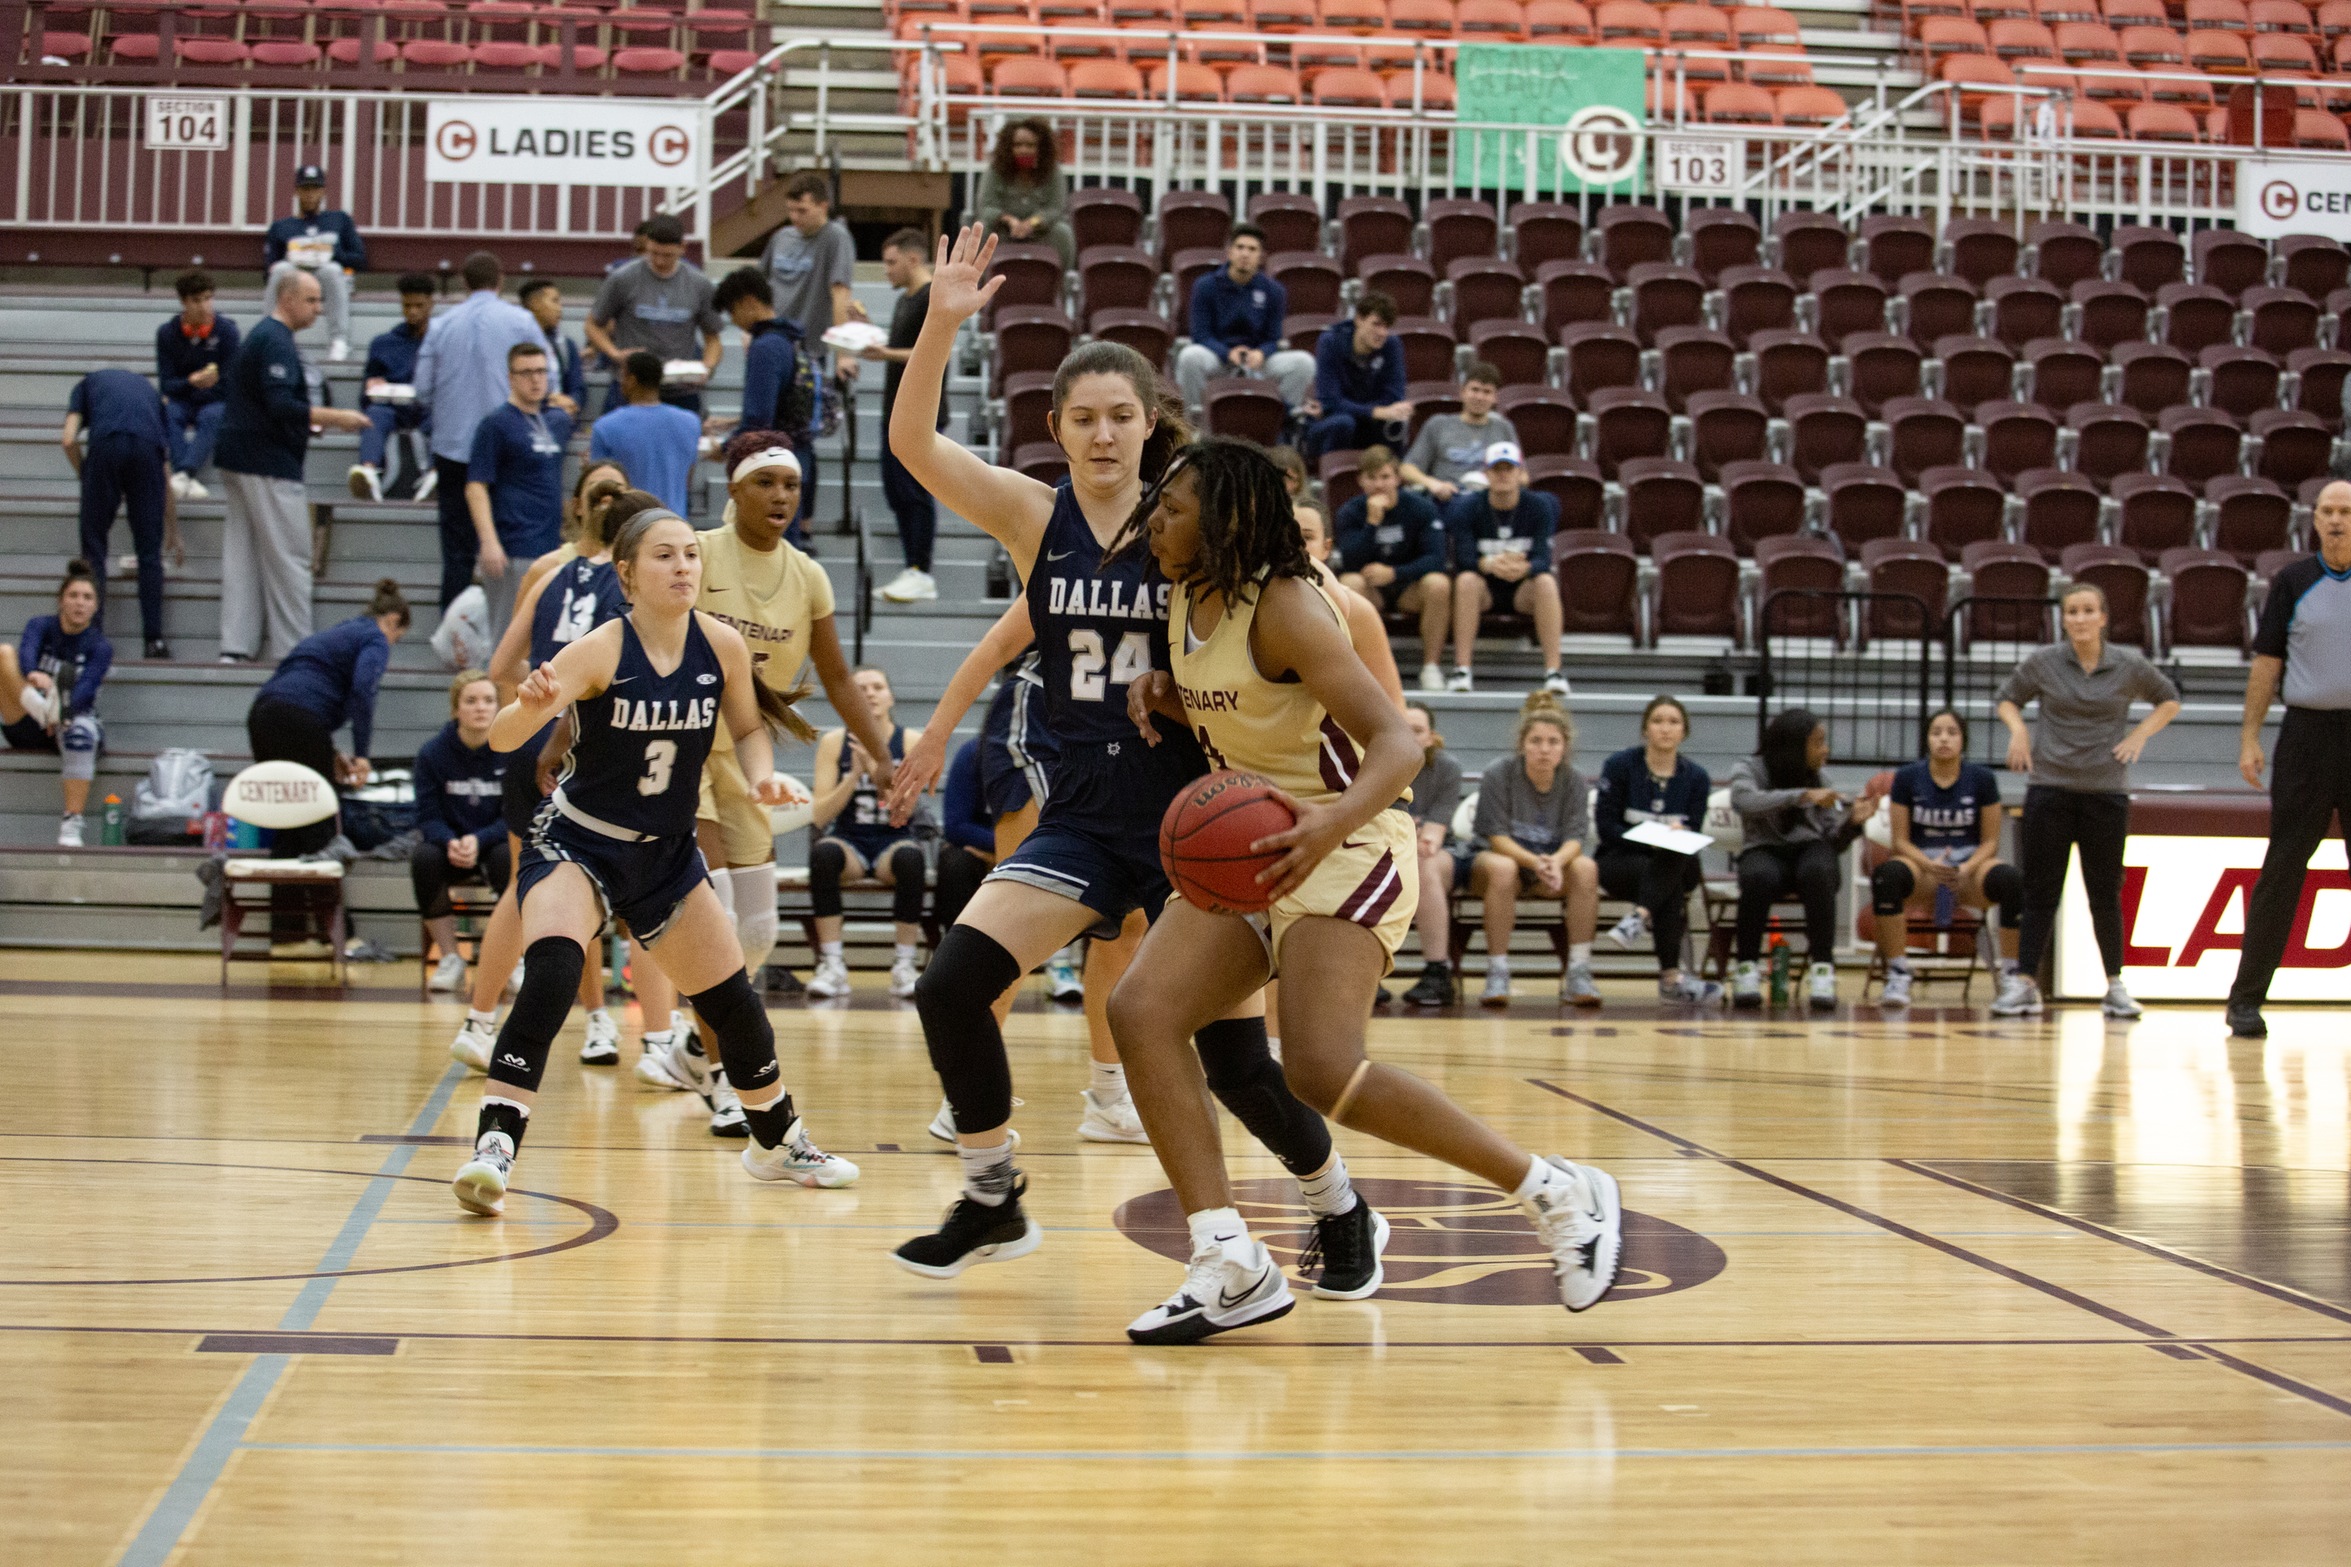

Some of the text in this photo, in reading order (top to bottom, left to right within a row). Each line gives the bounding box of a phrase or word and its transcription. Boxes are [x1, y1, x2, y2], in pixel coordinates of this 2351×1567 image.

[158, 101, 215, 113] SECTION
[159, 116, 216, 142] 104
[488, 128, 634, 159] LADIES
[1670, 143, 1725, 154] SECTION
[1669, 158, 1725, 184] 103
[1049, 576, 1173, 620] DALLAS
[1067, 628, 1156, 702] 24
[610, 697, 716, 731] DALLAS
[636, 739, 679, 797] 3
[1913, 805, 1975, 828] DALLAS
